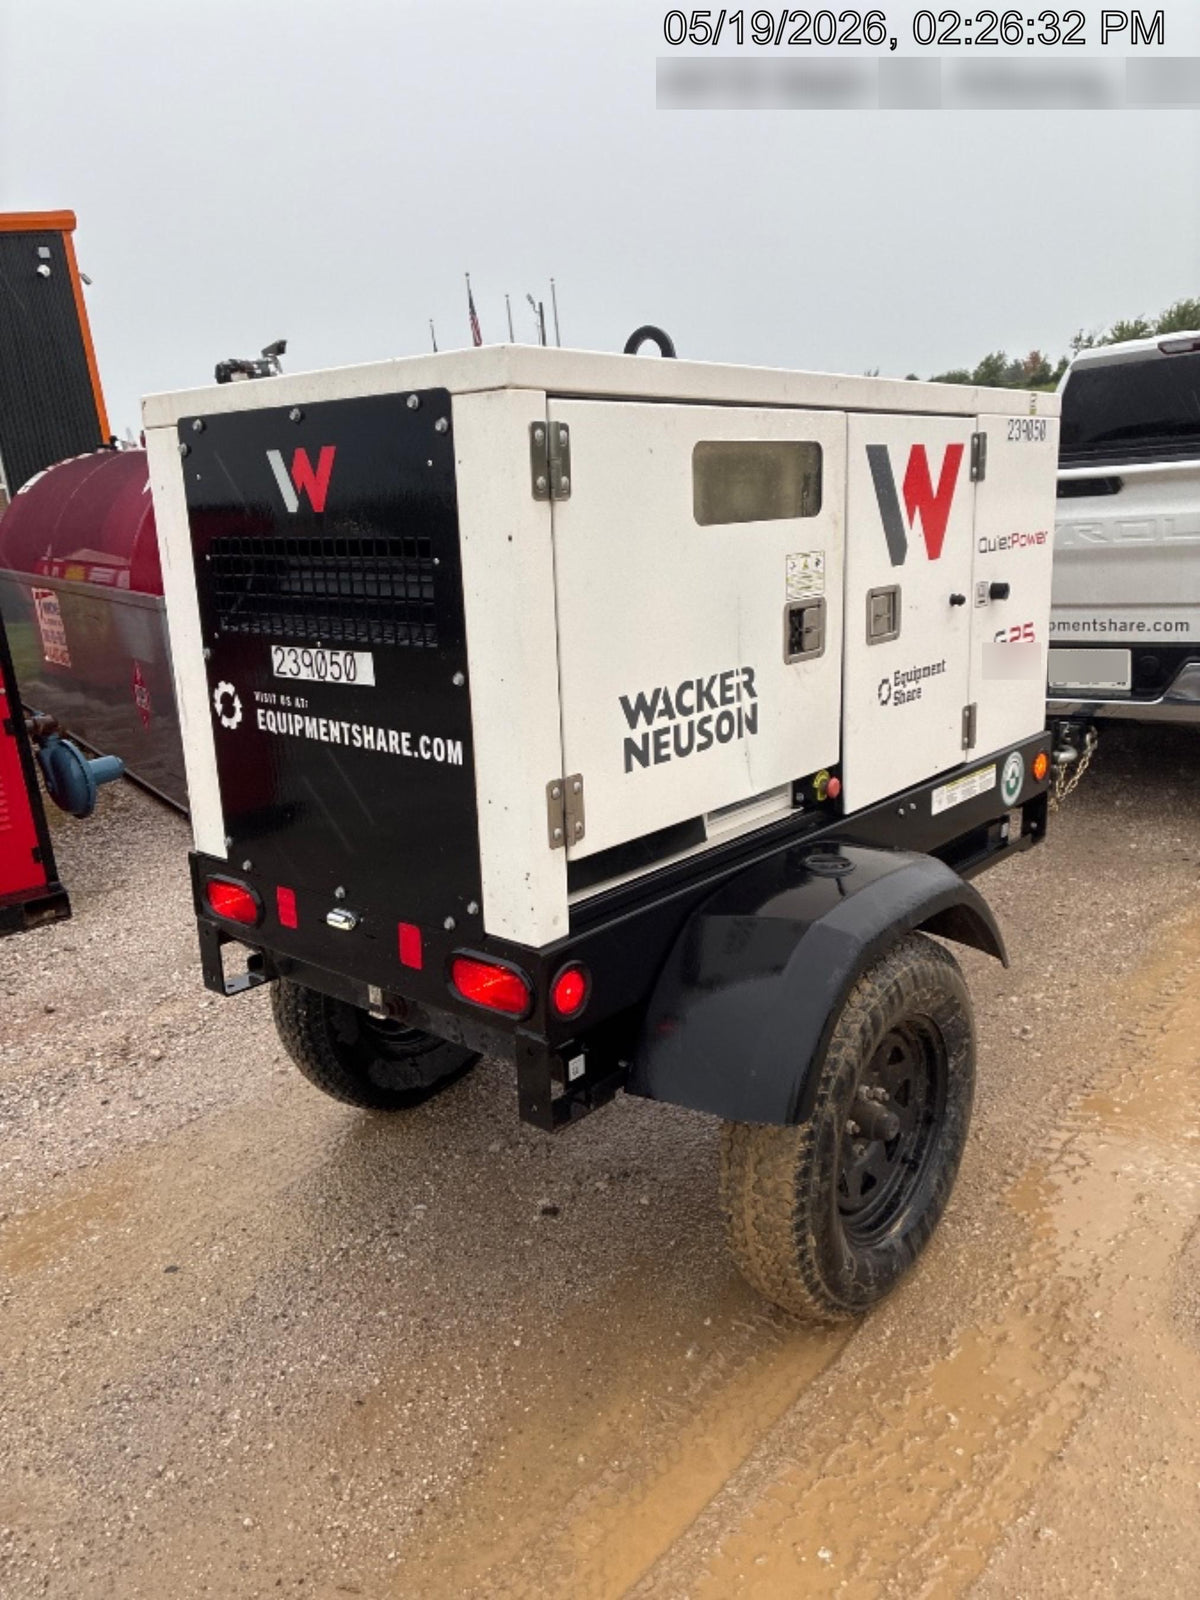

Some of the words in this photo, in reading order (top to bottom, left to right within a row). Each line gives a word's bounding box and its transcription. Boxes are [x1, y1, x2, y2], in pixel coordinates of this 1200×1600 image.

[1007, 419, 1047, 442] 239050
[978, 530, 1049, 554] QuietPower
[274, 646, 358, 682] 239050
[893, 659, 947, 688] Equipment
[253, 691, 277, 705] VISIT
[280, 694, 293, 707] US
[295, 697, 309, 709] AT:
[618, 666, 758, 730] WACKER
[893, 687, 922, 706] Share
[257, 708, 464, 766] EQUIPMENTSHARE.COM
[623, 701, 759, 774] NEUSON
